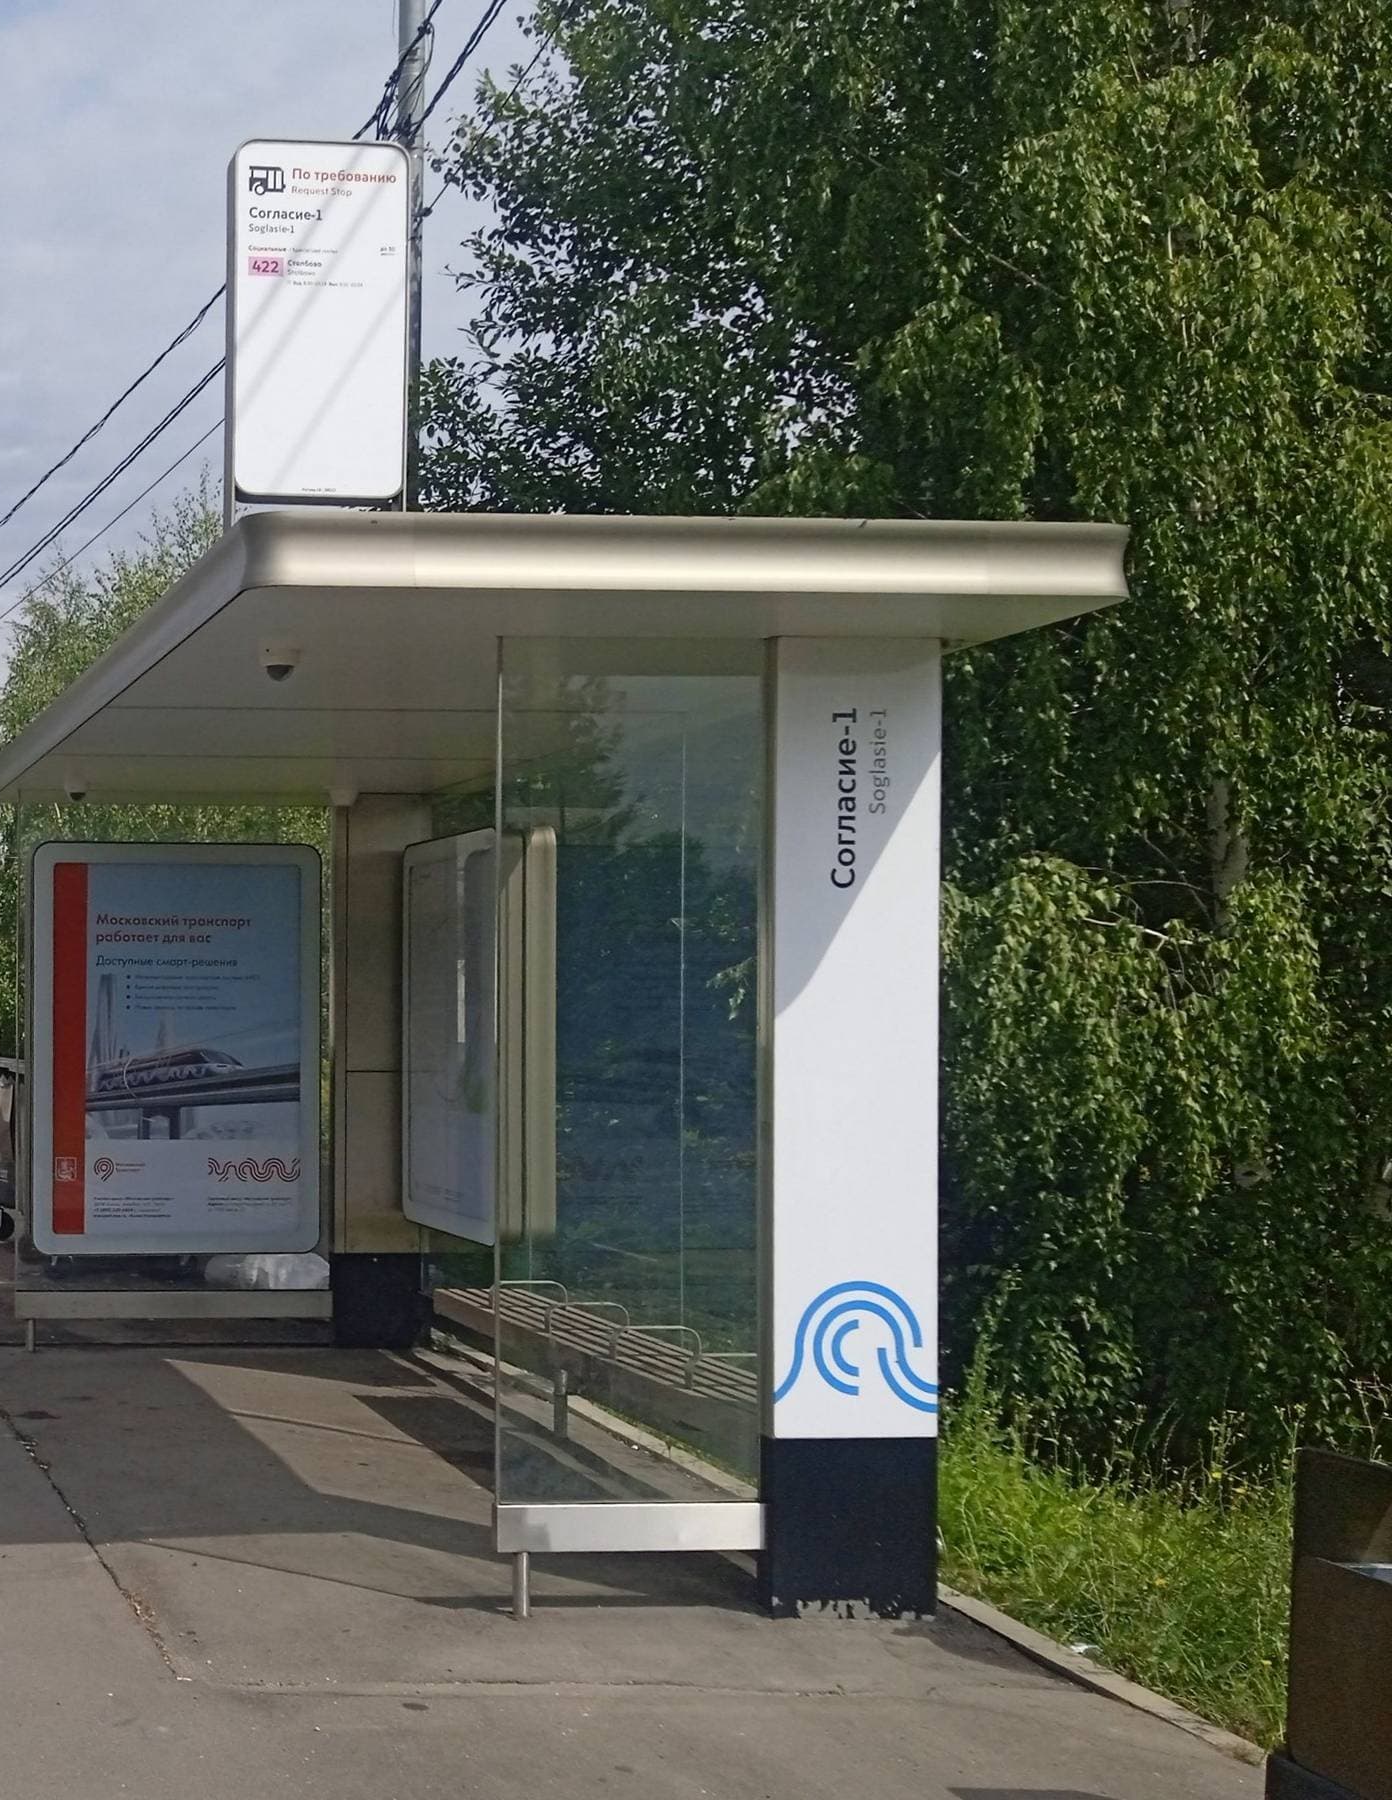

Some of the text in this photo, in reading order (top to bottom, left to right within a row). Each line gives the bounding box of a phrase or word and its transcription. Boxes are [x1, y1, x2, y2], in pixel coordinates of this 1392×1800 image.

[292, 168, 397, 184] По требованию
[291, 186, 352, 197] Request Stop
[249, 207, 322, 221] Согласие-1
[248, 223, 295, 234] Soglasie-1
[252, 260, 279, 273] 422
[868, 708, 890, 814] Soglasie-1
[830, 708, 857, 889] Согласие-1
[96, 914, 251, 929] Московский транспорт
[96, 931, 211, 945] работает для вас
[95, 955, 238, 968] Доступные смарт-решения
